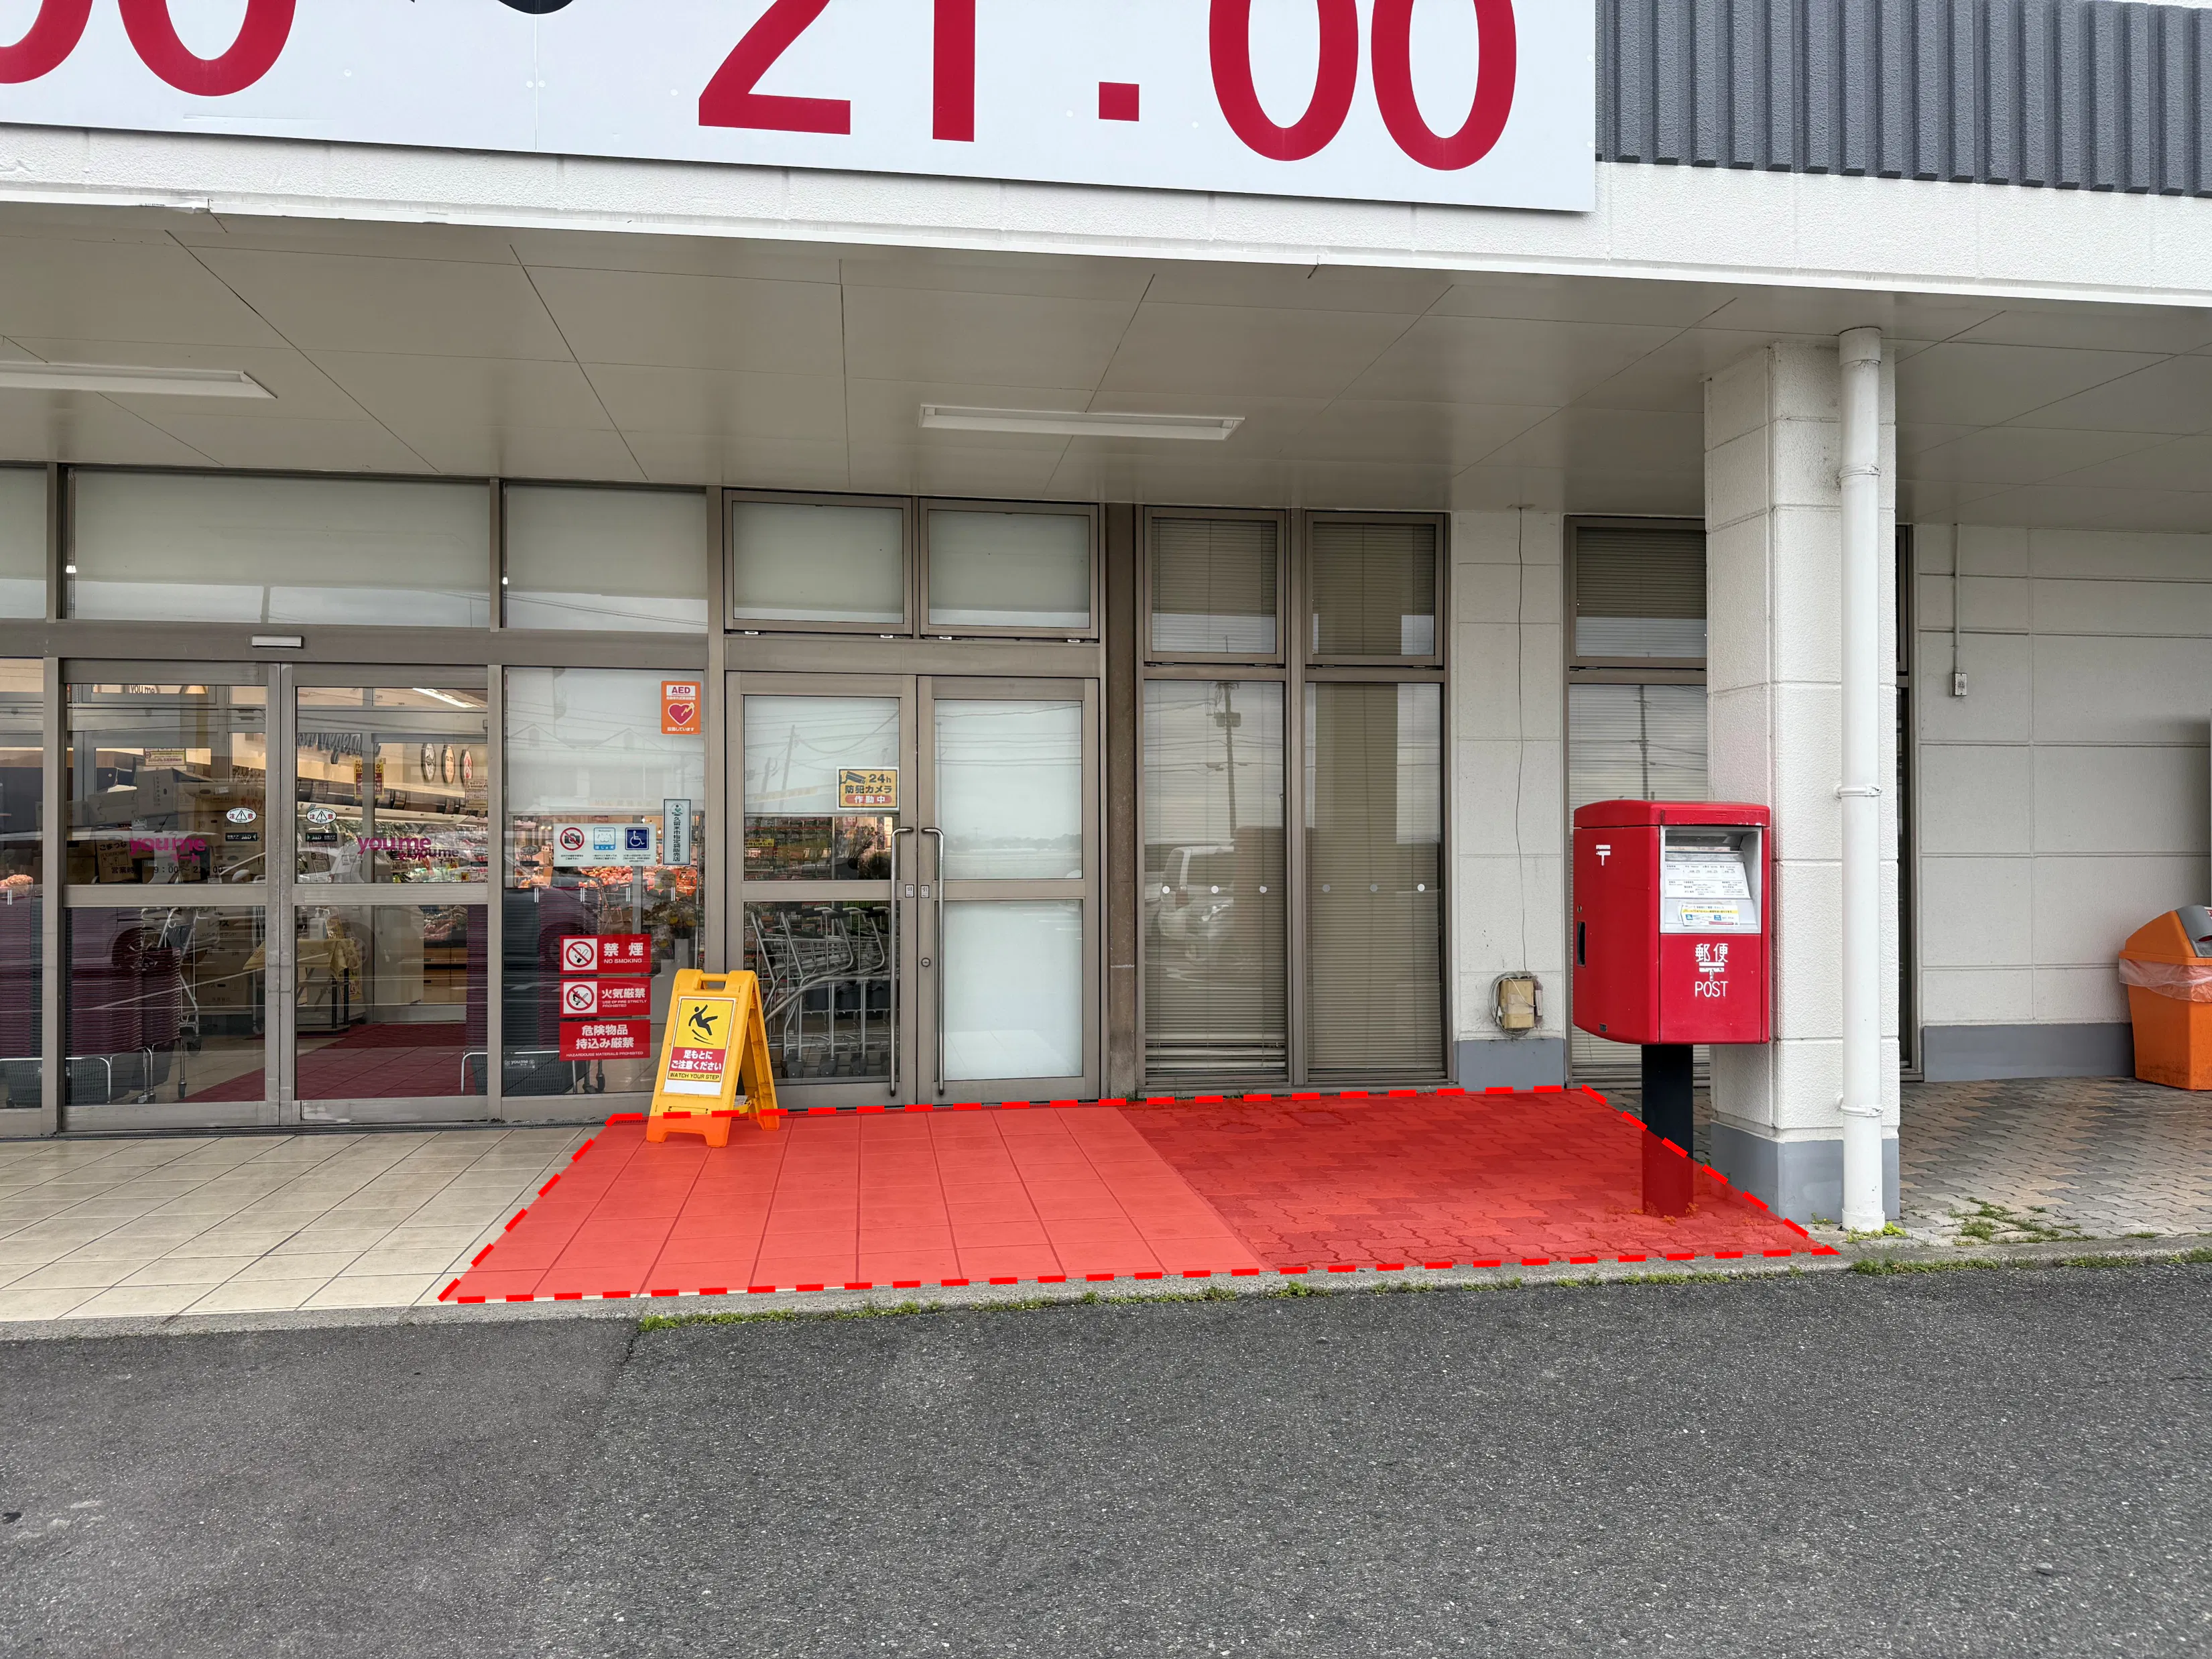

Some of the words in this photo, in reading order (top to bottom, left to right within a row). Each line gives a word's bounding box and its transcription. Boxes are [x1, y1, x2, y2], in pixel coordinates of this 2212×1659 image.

[869, 774, 892, 783] 24h
[845, 785, 892, 794] 防犯カメラ
[854, 796, 885, 804] 作動中
[673, 816, 681, 862] 久留米市指定袋販売店
[99, 842, 127, 851] こまつな
[129, 837, 206, 856] youme
[357, 836, 432, 855] youme
[604, 942, 643, 957] 禁煙
[1695, 943, 1728, 963] 郵便
[602, 987, 646, 999] 火気厳禁
[1695, 981, 1729, 997] POST
[582, 1024, 628, 1036] 危険物品
[576, 1037, 634, 1050] 持込み厳禁
[684, 1050, 713, 1060] 足もとに
[671, 1060, 721, 1070] ご注意ください
